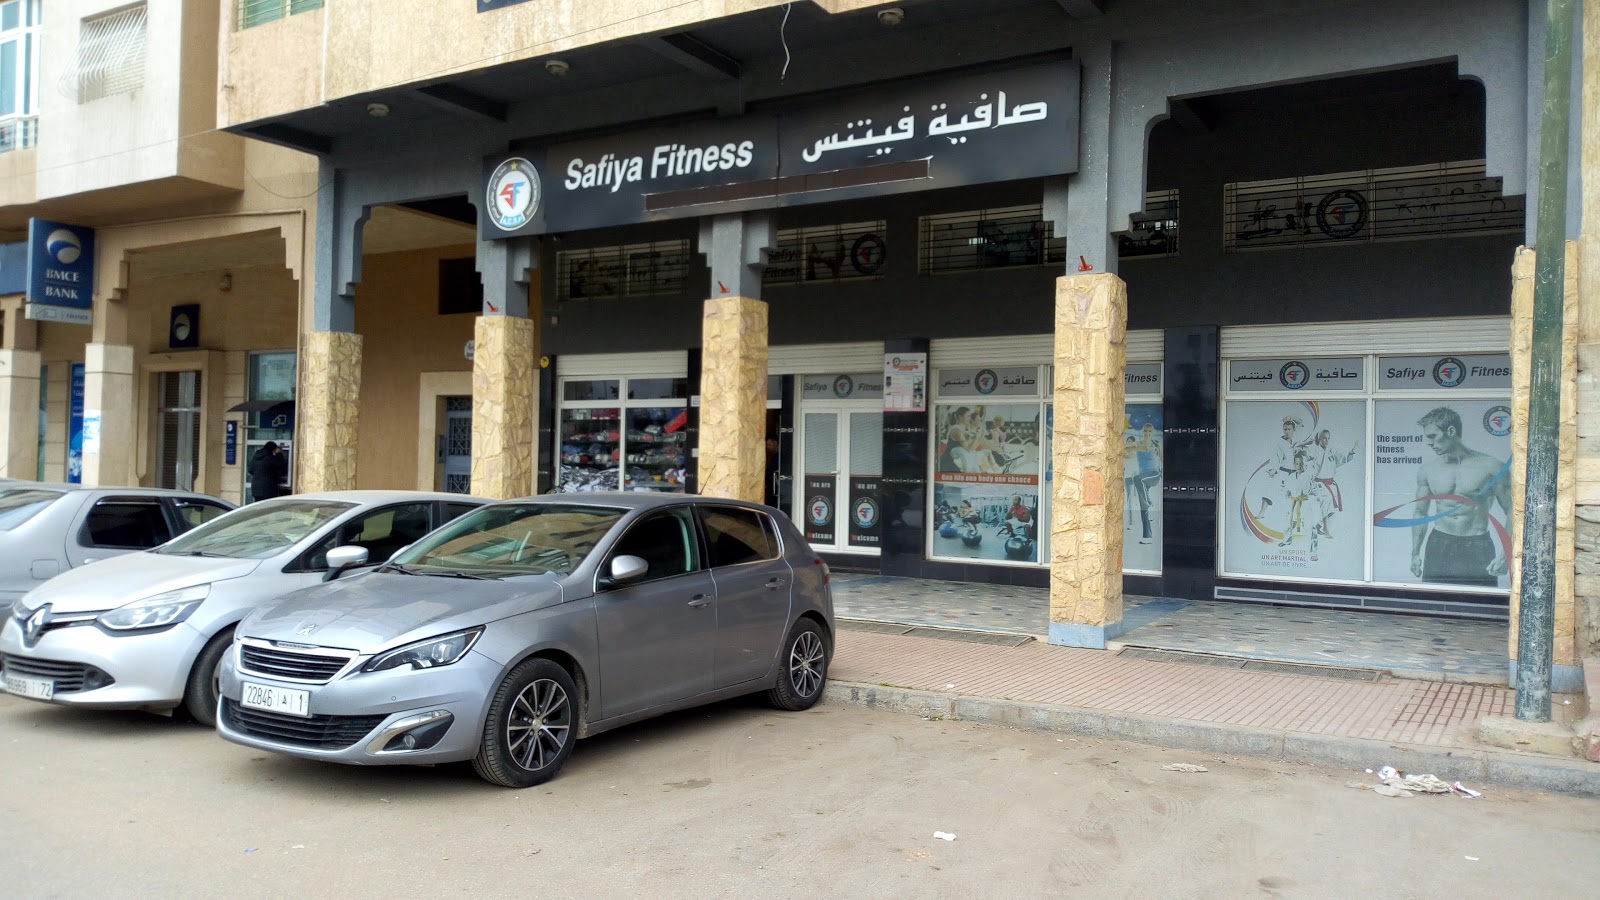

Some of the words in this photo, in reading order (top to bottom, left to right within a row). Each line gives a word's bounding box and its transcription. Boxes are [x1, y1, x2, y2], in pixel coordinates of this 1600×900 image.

[926, 90, 1048, 145] صافية
[802, 105, 915, 163] فيتنس
[564, 153, 643, 194] Safiya
[650, 140, 754, 179] Fitness
[46, 268, 80, 282] BMCE
[45, 285, 78, 299] BANK
[1316, 367, 1358, 382] صافية
[1386, 367, 1426, 380] Safiya
[1471, 366, 1512, 377] Fitnes
[804, 382, 828, 392] Safiya
[1376, 435, 1390, 443] the
[1391, 435, 1413, 444] sport
[1415, 434, 1423, 443] of
[1376, 445, 1405, 453] fitness
[1376, 456, 1391, 464] has
[1393, 456, 1422, 464] arrived
[807, 532, 832, 540] Welcome
[41, 682, 52, 697] 72
[246, 685, 273, 707] 22846
